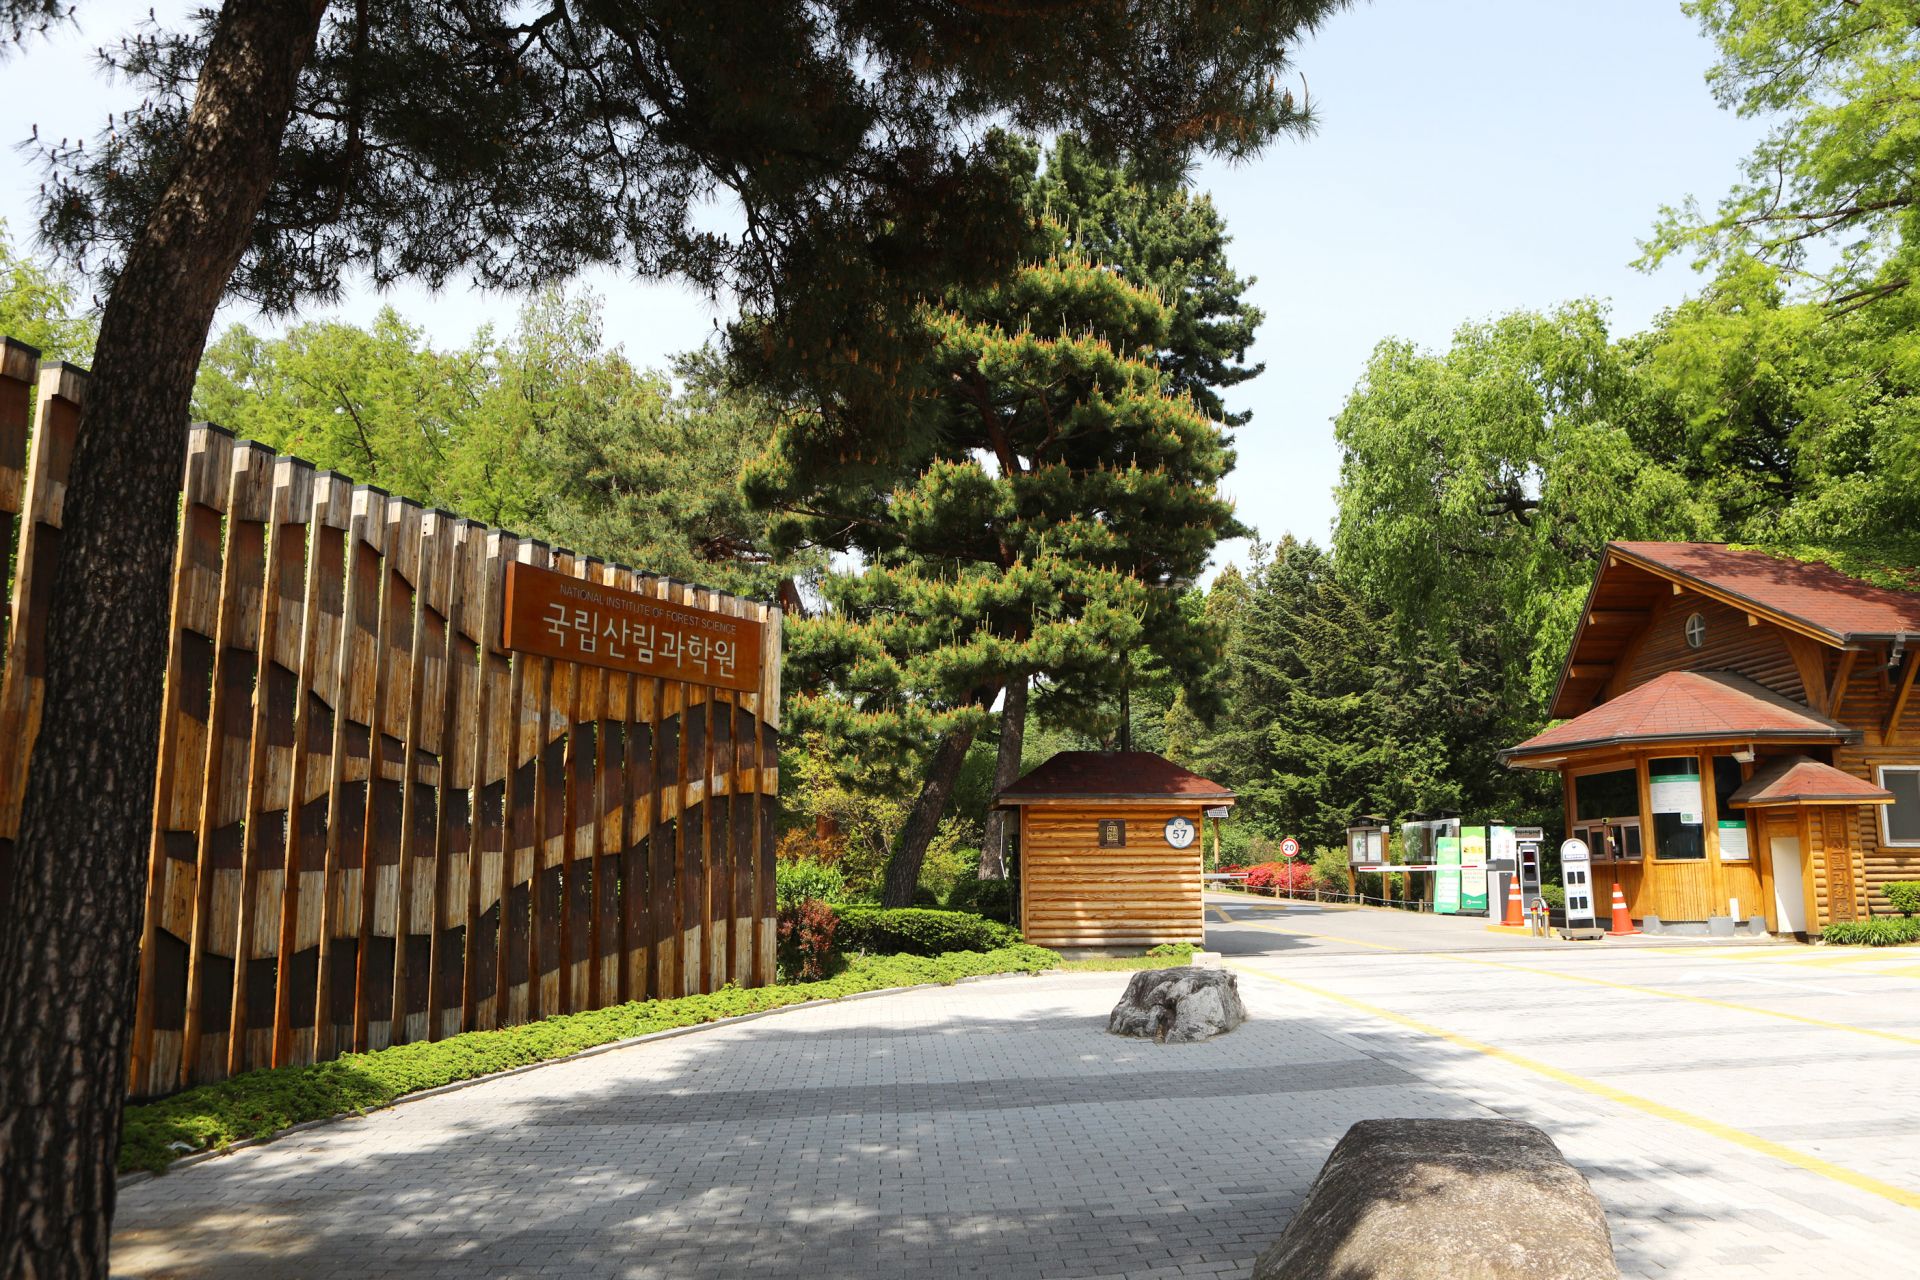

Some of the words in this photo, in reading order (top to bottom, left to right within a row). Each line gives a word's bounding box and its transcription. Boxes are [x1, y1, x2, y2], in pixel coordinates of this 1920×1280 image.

[559, 584, 604, 604] NATIONAL
[605, 597, 651, 615] INSTITUTE
[652, 608, 663, 619] OF
[666, 611, 700, 627] FOREST
[701, 619, 737, 635] SCIENCE
[543, 602, 737, 679] 국립산림과학원
[1172, 829, 1188, 840] 57
[1284, 844, 1295, 852] 20
